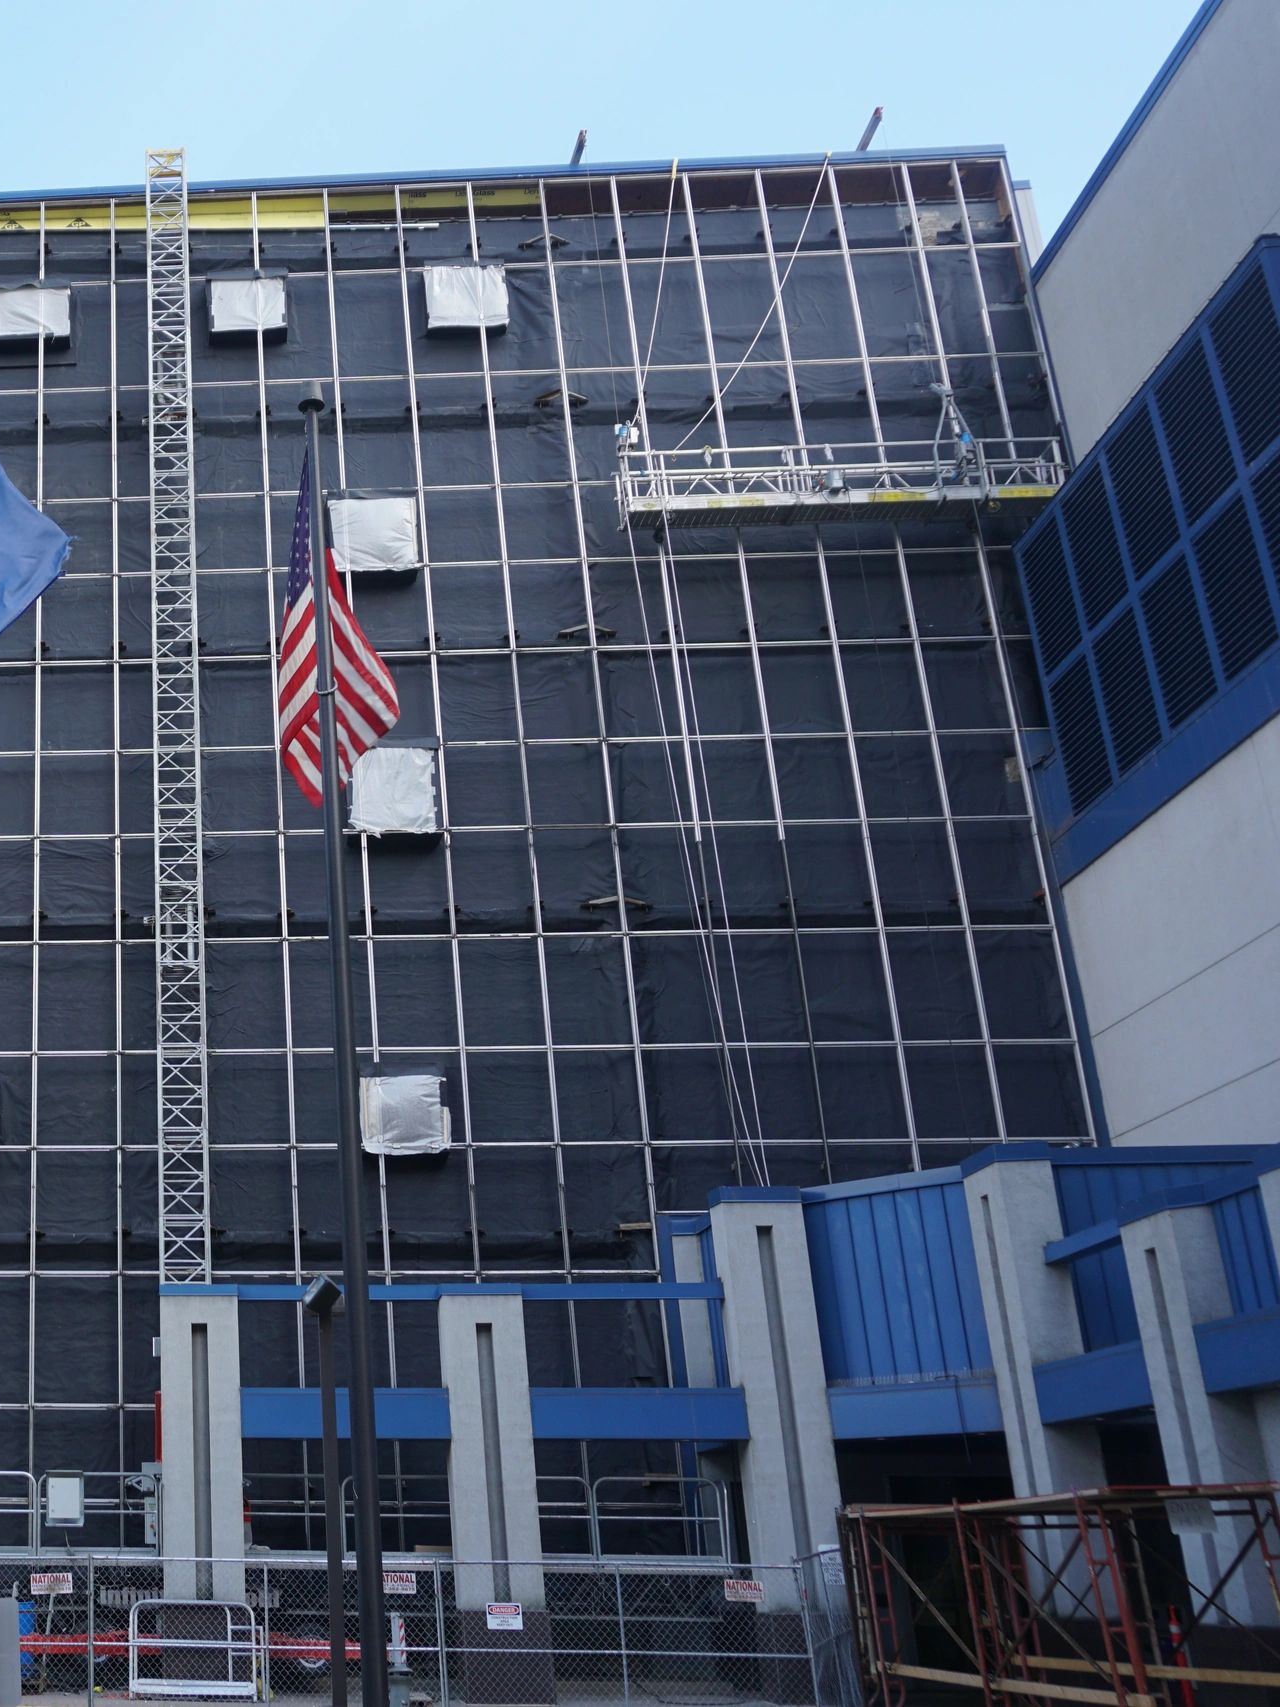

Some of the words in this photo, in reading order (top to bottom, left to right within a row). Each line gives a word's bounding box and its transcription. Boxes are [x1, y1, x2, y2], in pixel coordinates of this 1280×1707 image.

[32, 1574, 71, 1585] NATIONAL
[383, 1573, 414, 1584] TIONAL
[726, 1581, 762, 1592] NATIONAL
